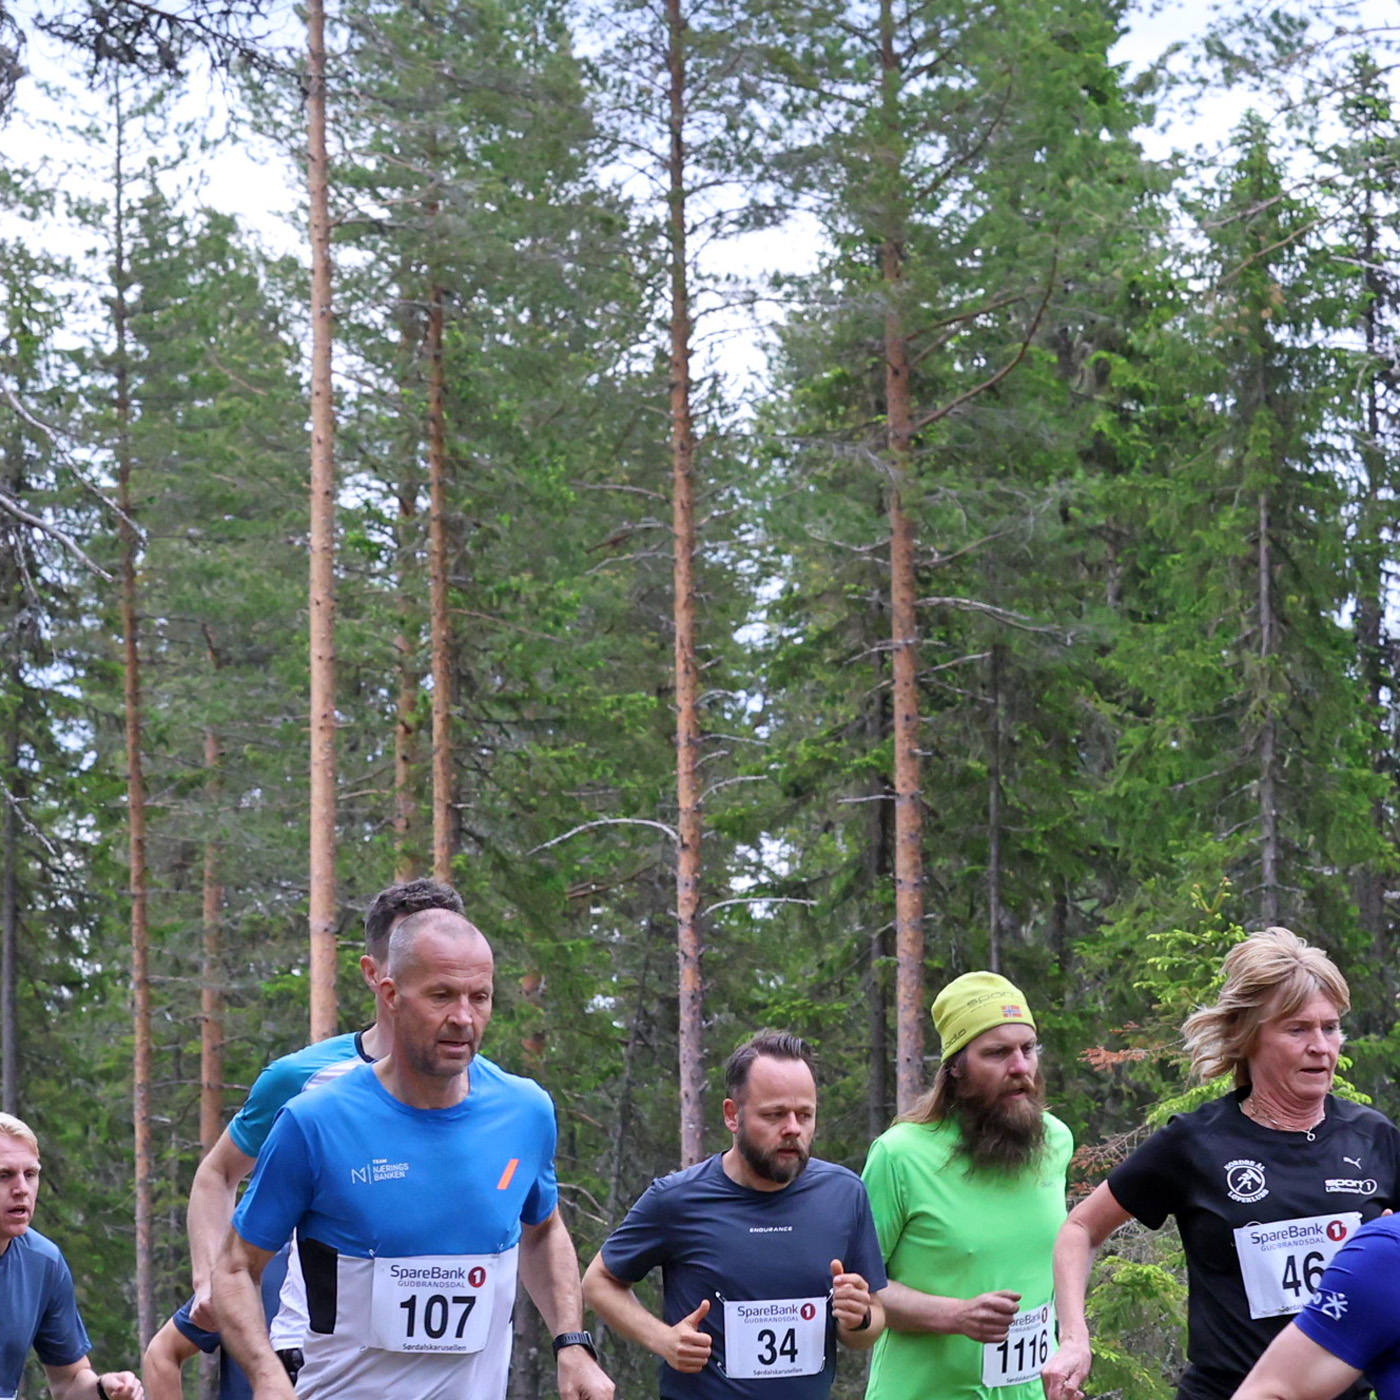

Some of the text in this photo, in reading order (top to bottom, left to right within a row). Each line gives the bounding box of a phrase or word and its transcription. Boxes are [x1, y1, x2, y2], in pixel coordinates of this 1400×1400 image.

[372, 1163, 410, 1173] NÆRINGS
[373, 1171, 406, 1182] BANKEN
[749, 1225, 793, 1233] ENDURANCE
[1250, 1222, 1324, 1245] SpareBank
[1260, 1237, 1326, 1252] GUDBRANDSDAL
[390, 1264, 466, 1280] SpareBank
[1281, 1251, 1325, 1297] 46
[397, 1280, 466, 1288] GUDBRANDSDAL
[399, 1294, 477, 1339] 107
[737, 1303, 799, 1318] SpareBank
[744, 1315, 800, 1324] GUDBRANDSDAL
[1010, 1312, 1040, 1327] areBank
[402, 1342, 468, 1352] Sørdalskarusellen
[757, 1327, 799, 1366] 34
[997, 1329, 1048, 1374] 1116
